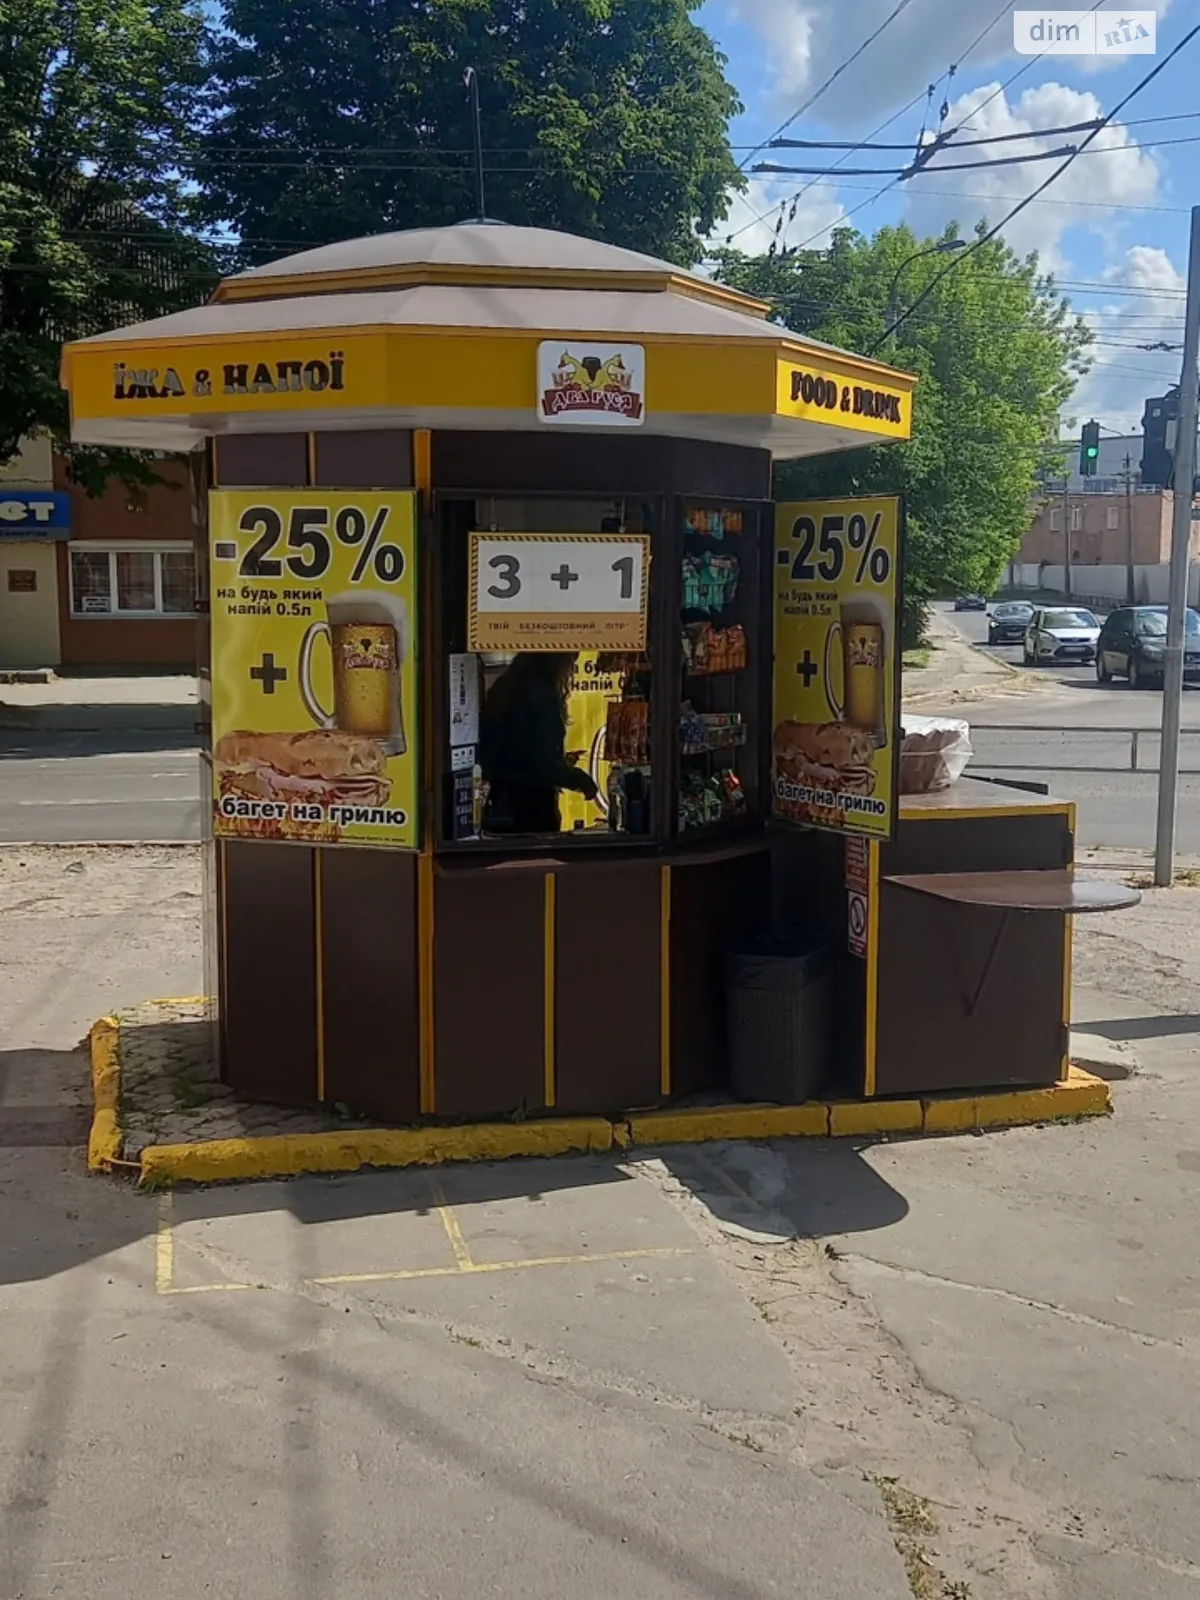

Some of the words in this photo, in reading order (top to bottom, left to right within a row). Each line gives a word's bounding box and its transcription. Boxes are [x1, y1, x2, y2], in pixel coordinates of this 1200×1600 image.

[113, 362, 186, 399] ЇЖА
[192, 369, 212, 397] &
[223, 351, 344, 394] НАПОЇ
[790, 370, 838, 411] FOOD
[840, 386, 851, 413] &
[852, 386, 902, 425] DRINK
[214, 506, 405, 582] -25%
[777, 513, 890, 583] -25%
[216, 588, 236, 599] на
[241, 585, 278, 601] будь
[282, 587, 323, 601] який
[487, 554, 522, 599] 3
[611, 556, 635, 599] 1
[227, 602, 271, 616] напій
[276, 604, 312, 617] 0.5л
[519, 620, 597, 631] БЕЗКОШТОВНИЙ
[571, 676, 613, 691] напій
[221, 796, 286, 817] багет
[293, 804, 322, 820] на
[329, 805, 406, 826] грилю
[777, 779, 814, 802] багет
[816, 790, 834, 805] на
[837, 794, 887, 815] грилю
